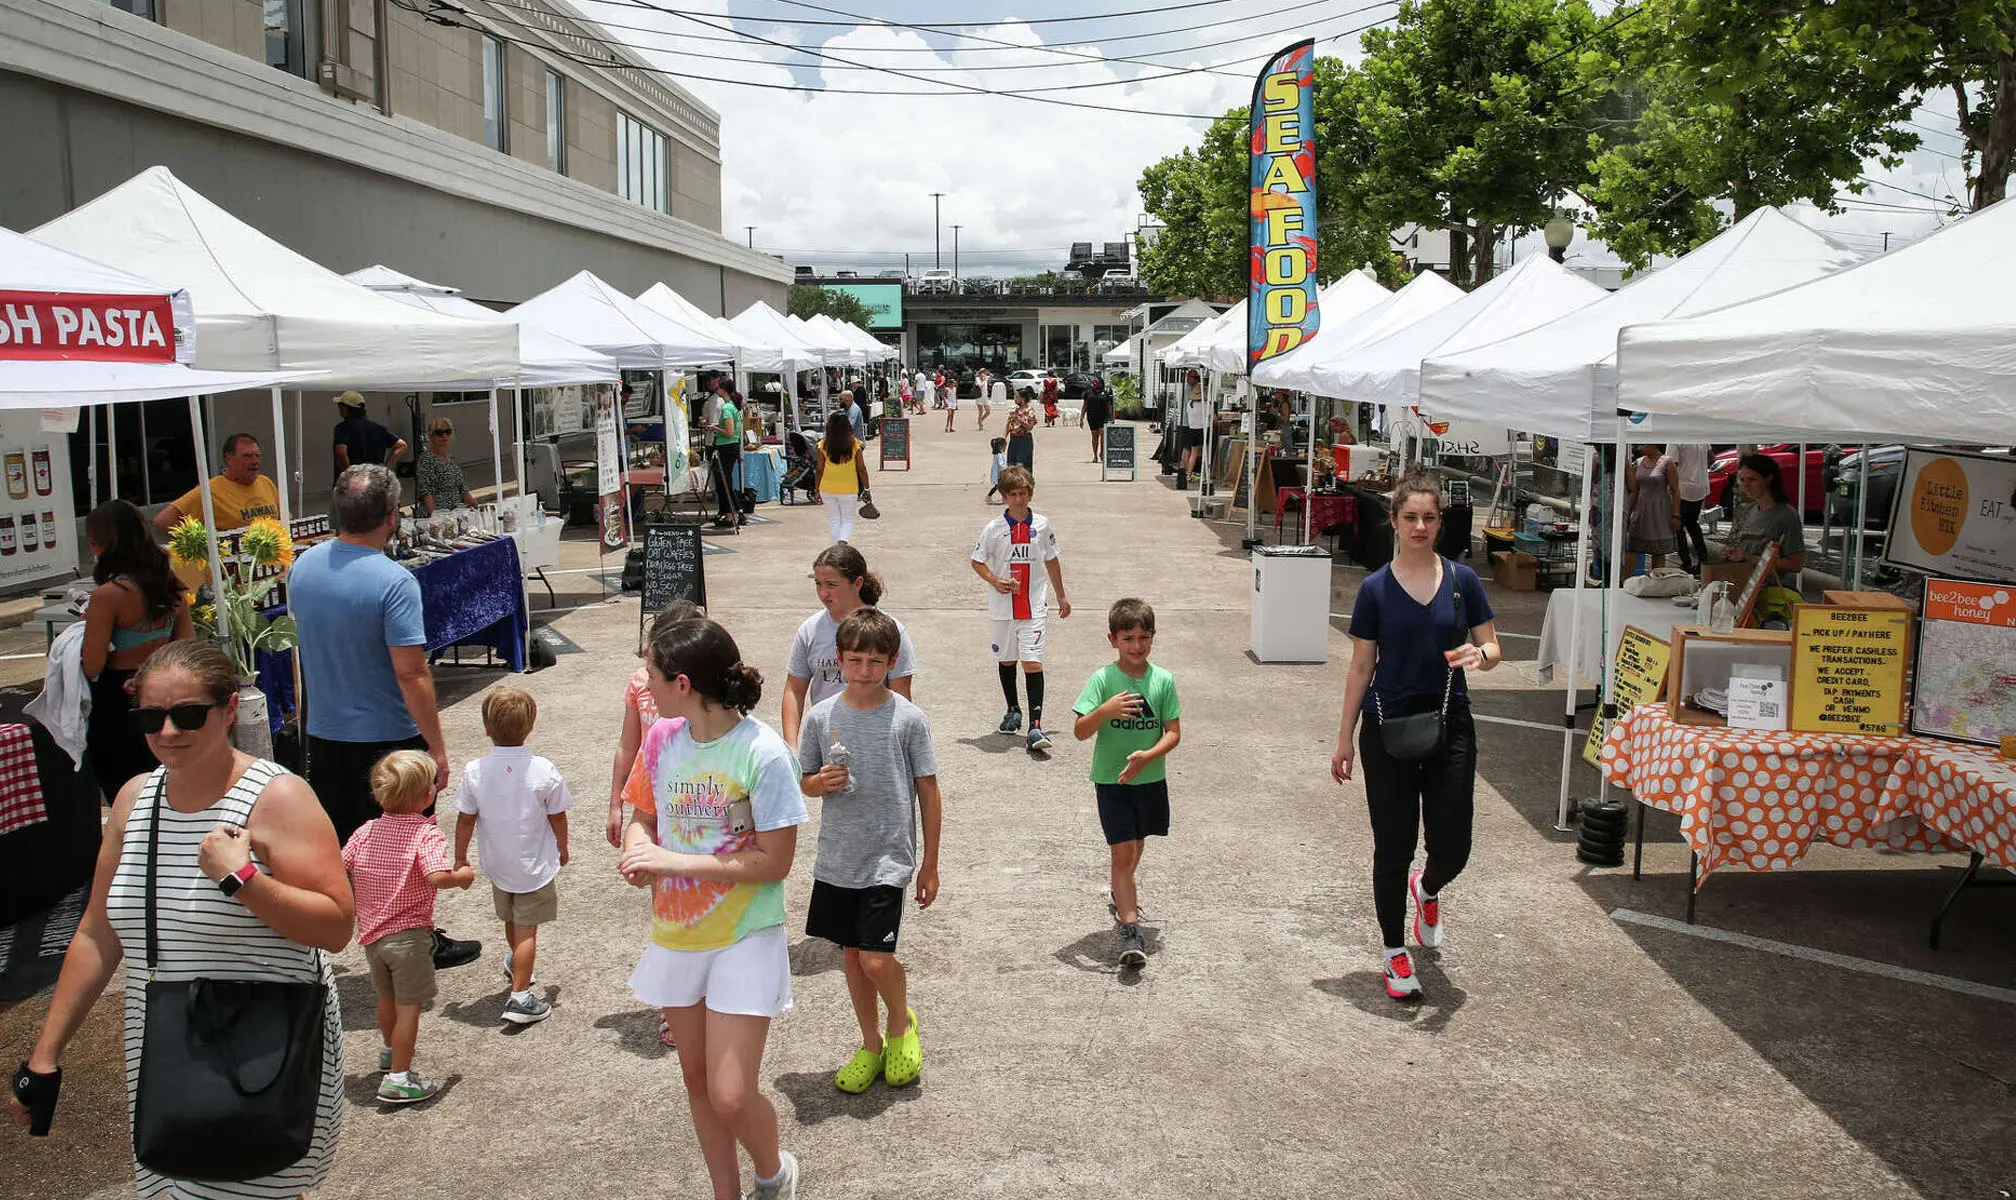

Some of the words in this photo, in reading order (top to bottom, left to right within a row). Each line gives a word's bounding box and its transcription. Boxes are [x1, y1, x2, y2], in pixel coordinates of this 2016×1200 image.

[1259, 71, 1309, 361] SEAFOOD
[52, 306, 166, 347] PASTA
[1980, 499, 2005, 519] EAT
[1929, 590, 1978, 606] bee2bee
[1831, 612, 1869, 622] BEE2BEE
[1954, 605, 1991, 623] honey
[1033, 630, 1042, 645] 7
[1813, 629, 1830, 637] PICK
[1832, 629, 1844, 638] UP
[1809, 645, 1820, 653] WE
[1823, 646, 1853, 654] PREFER
[1856, 647, 1897, 656] CASHLESS
[817, 658, 840, 668] HAR
[823, 669, 848, 684] LA
[1816, 677, 1844, 685] CREDIT
[1824, 688, 1838, 696] TAP
[1833, 697, 1855, 705] CASH
[1825, 704, 1836, 712] OR
[1843, 705, 1871, 713] VENMO
[1110, 717, 1160, 730] adidas
[665, 774, 725, 801] simply
